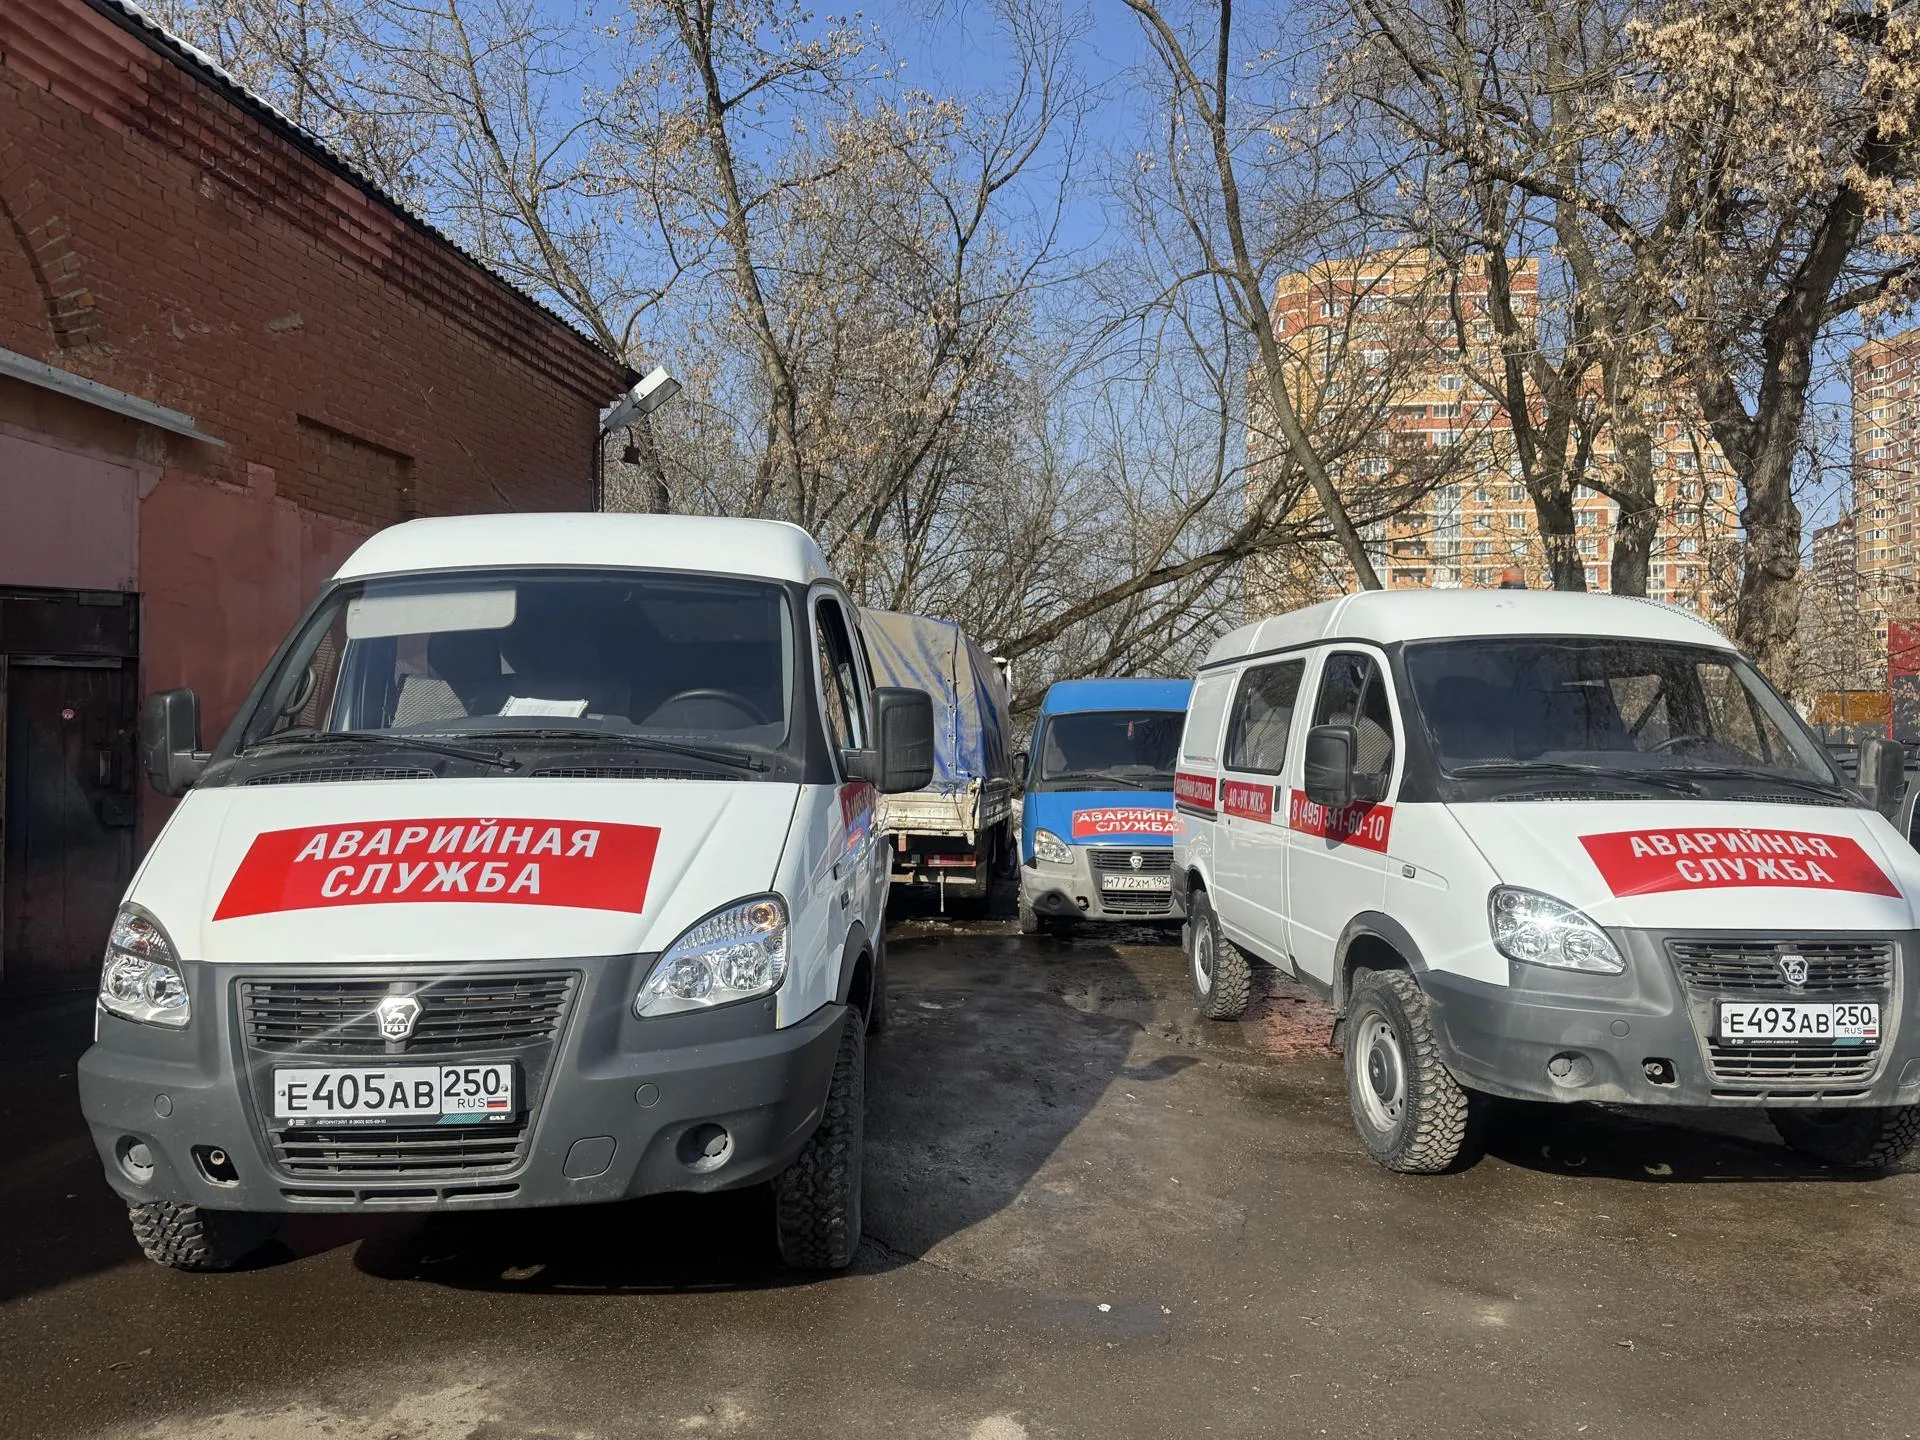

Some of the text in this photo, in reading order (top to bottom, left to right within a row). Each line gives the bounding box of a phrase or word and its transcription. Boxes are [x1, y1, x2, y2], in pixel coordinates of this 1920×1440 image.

[1228, 788, 1237, 807] АО
[1078, 809, 1174, 823] АВАРИЙН
[1095, 821, 1175, 832] СЛУЖБА
[1292, 799, 1385, 842] 8 (495) 541-60-10
[294, 818, 600, 863] АВАРИЙНАЯ
[1629, 828, 1838, 858] АВАРИЙНАЯ
[320, 861, 541, 898] СЛУЖБА
[1675, 857, 1835, 883] СЛУЖБА
[1835, 1006, 1872, 1026] 250
[1844, 1027, 1862, 1035] RUS
[443, 1068, 501, 1097] 250
[457, 1098, 485, 1108] RUS
